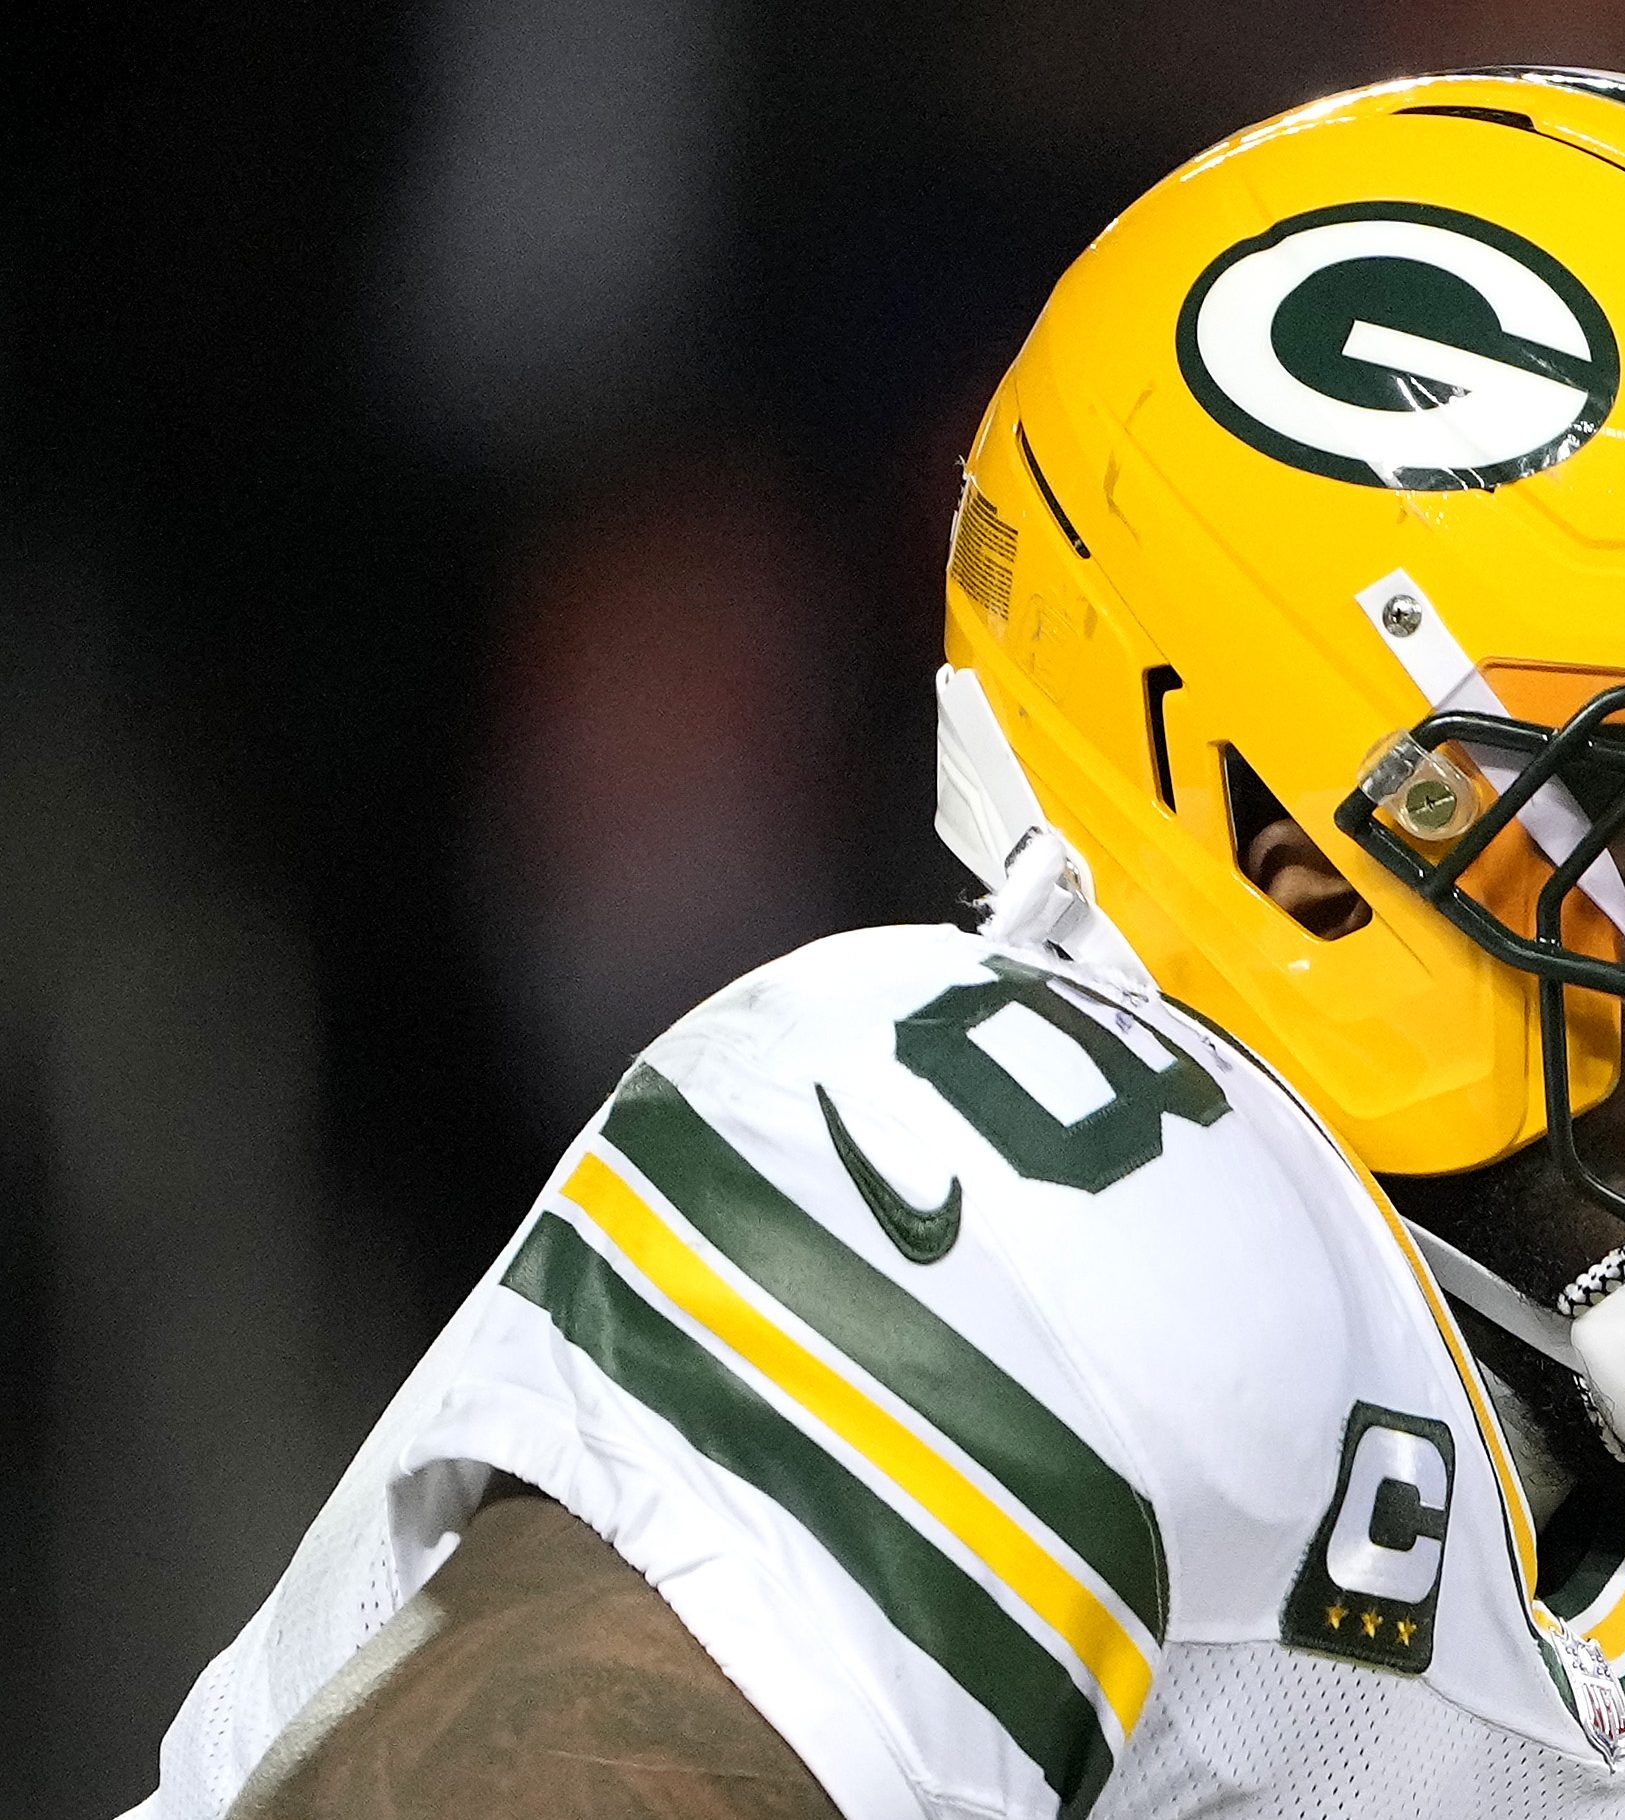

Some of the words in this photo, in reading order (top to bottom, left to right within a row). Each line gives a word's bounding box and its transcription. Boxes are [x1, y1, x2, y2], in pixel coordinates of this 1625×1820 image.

[1196, 219, 1593, 470] G
[892, 953, 1234, 1195] 8
[1326, 1424, 1448, 1605] C
